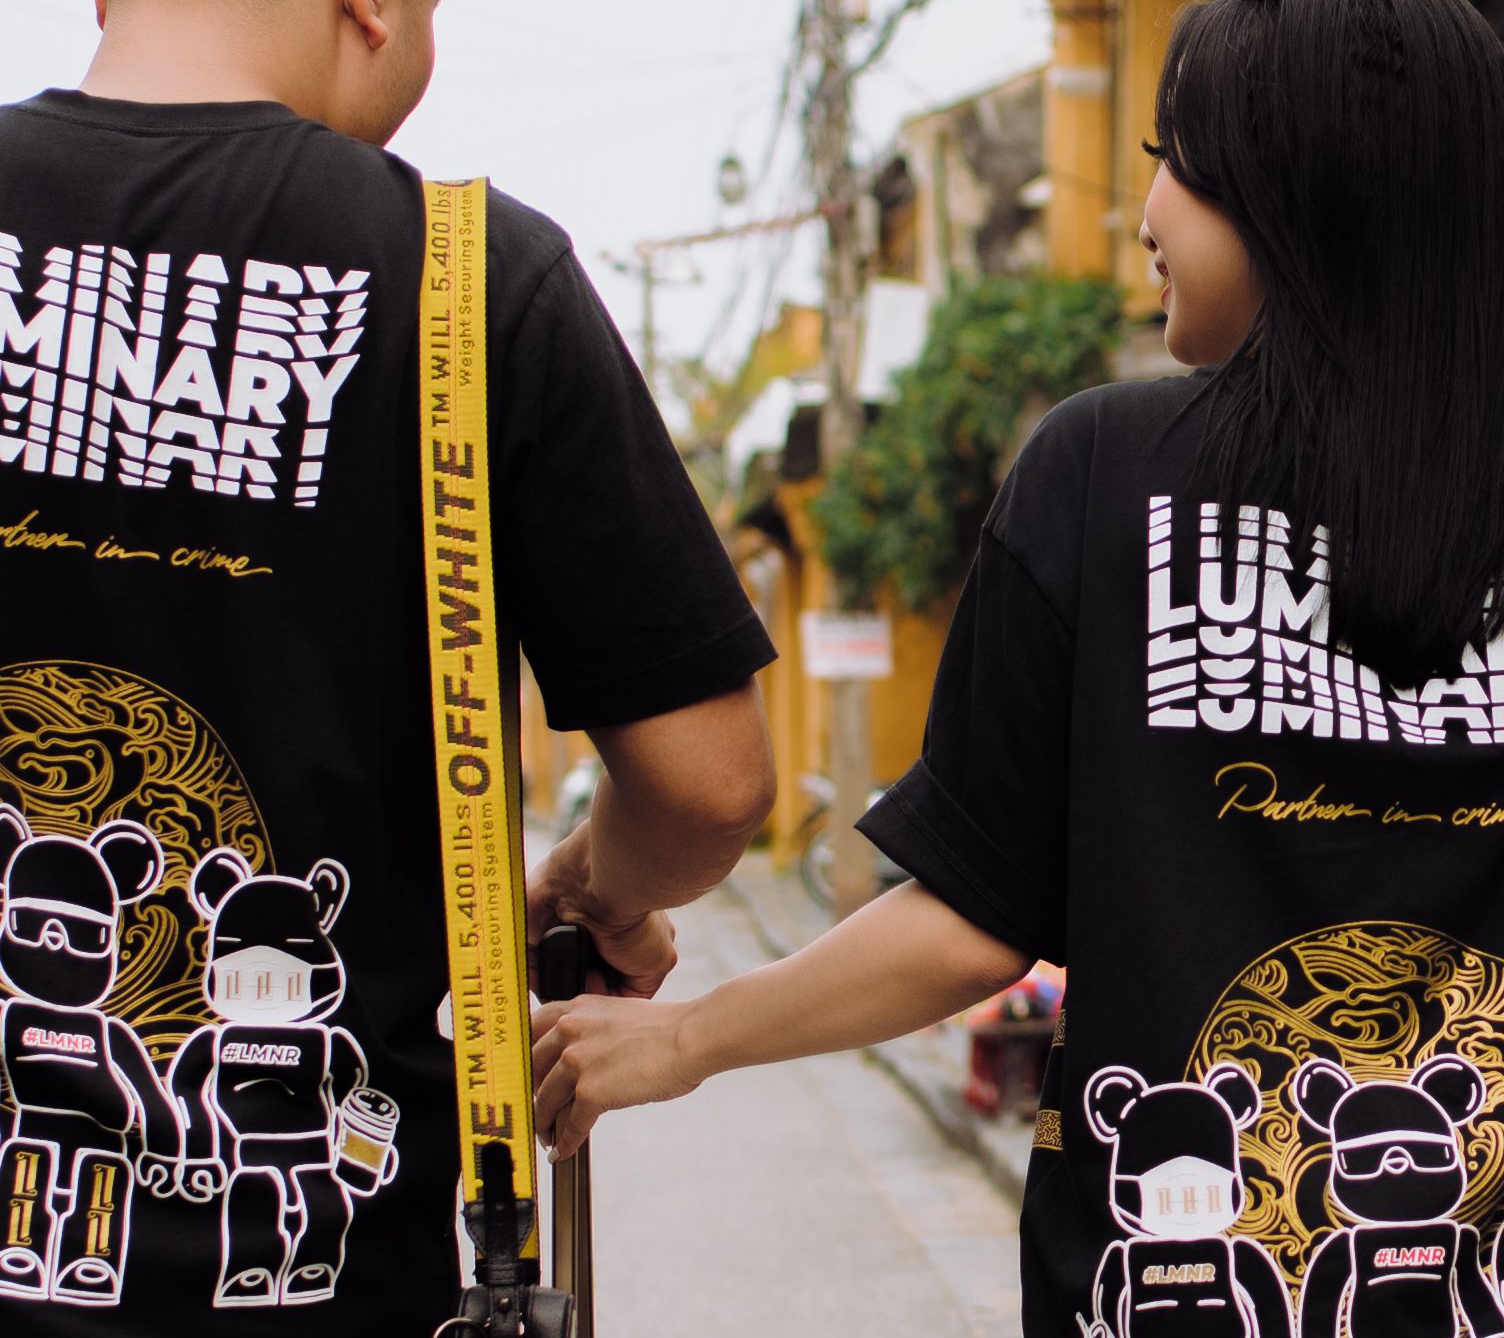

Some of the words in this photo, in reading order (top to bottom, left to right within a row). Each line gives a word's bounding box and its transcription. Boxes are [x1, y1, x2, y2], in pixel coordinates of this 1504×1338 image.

[458, 189, 475, 236] System
[431, 221, 454, 293] 5,400
[458, 239, 476, 315] Securing
[431, 309, 452, 384] WILL
[458, 318, 475, 387] Weight
[96, 536, 160, 560] in
[170, 546, 273, 577] crime
[432, 439, 491, 798] OFF-WHITE
[1215, 761, 1372, 822] Partner
[1382, 801, 1442, 823] in
[453, 804, 473, 853] lbs
[482, 800, 496, 877] System
[456, 863, 482, 949] 5,400
[486, 882, 502, 972] Securing
[462, 965, 484, 1042] WILL
[492, 975, 508, 1046] Weight
[22, 1026, 97, 1053] #LMNR
[221, 1042, 302, 1066] #LMNR
[1142, 1263, 1216, 1285] #LMNR
[1374, 1246, 1446, 1268] #LMNR
